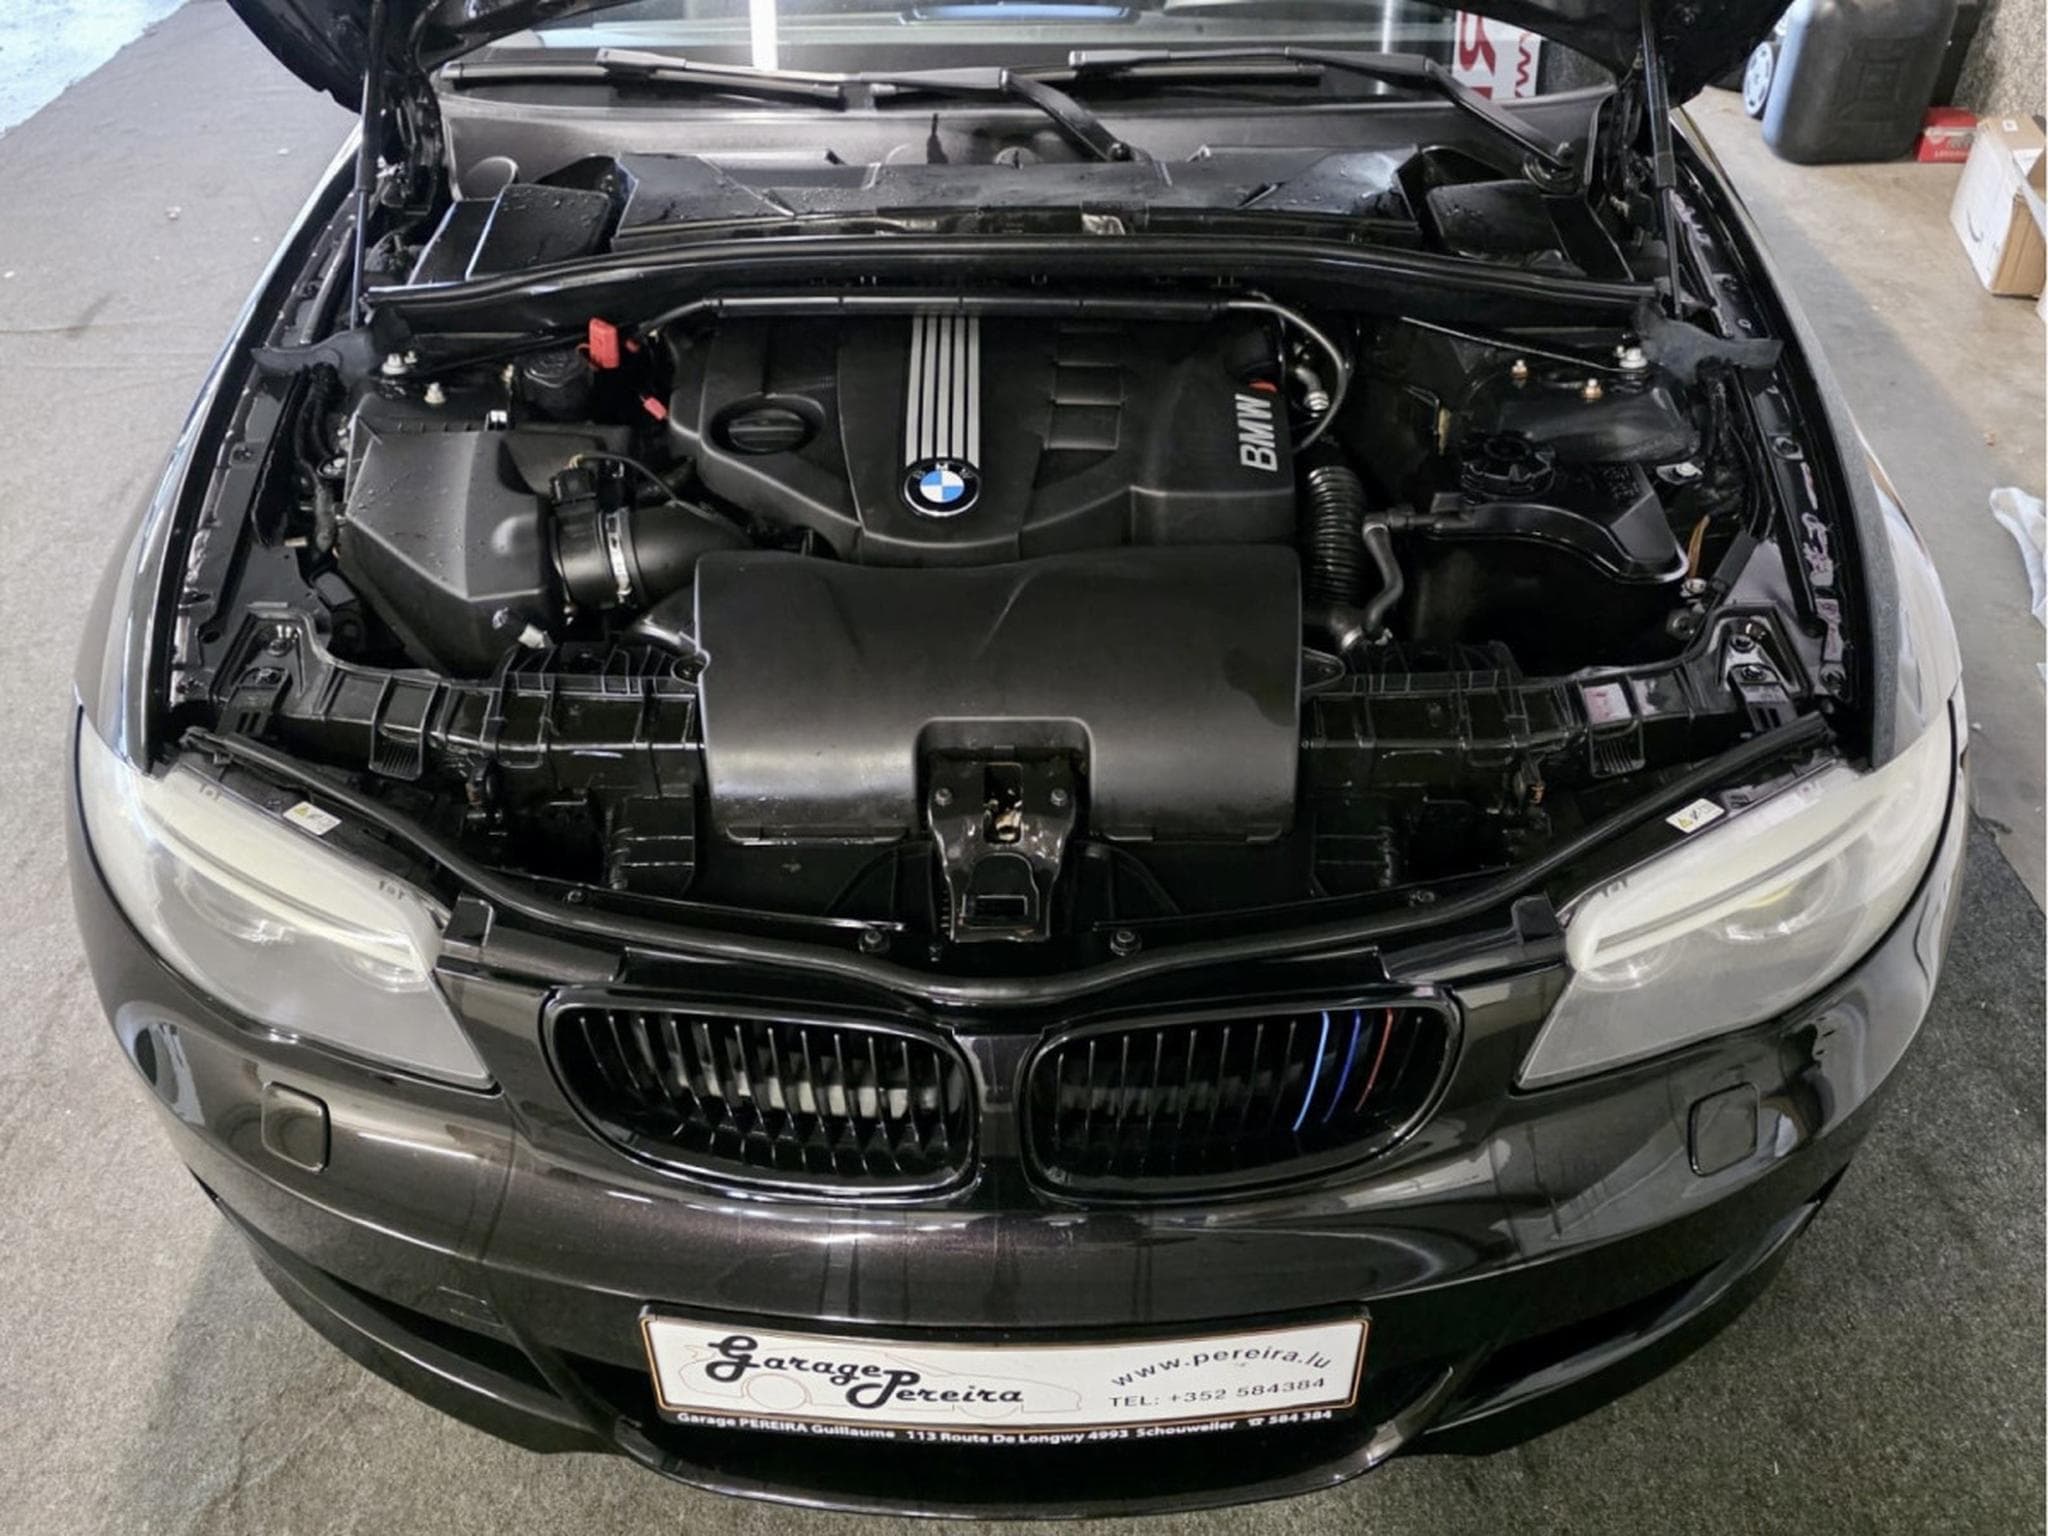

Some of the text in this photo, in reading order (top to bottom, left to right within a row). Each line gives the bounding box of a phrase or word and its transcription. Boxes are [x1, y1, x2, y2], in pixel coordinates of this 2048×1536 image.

[1235, 393, 1278, 472] BMW
[705, 1336, 881, 1386] Garage
[1111, 1345, 1332, 1387] www.pereira.lu
[845, 1369, 1024, 1409] Pereira
[1108, 1377, 1326, 1408] TEL: +352 584384
[676, 1409, 1333, 1445] Garage PEREIRA Guillaume 113 Route De Longwy 4993 Schouweiler 584 384
